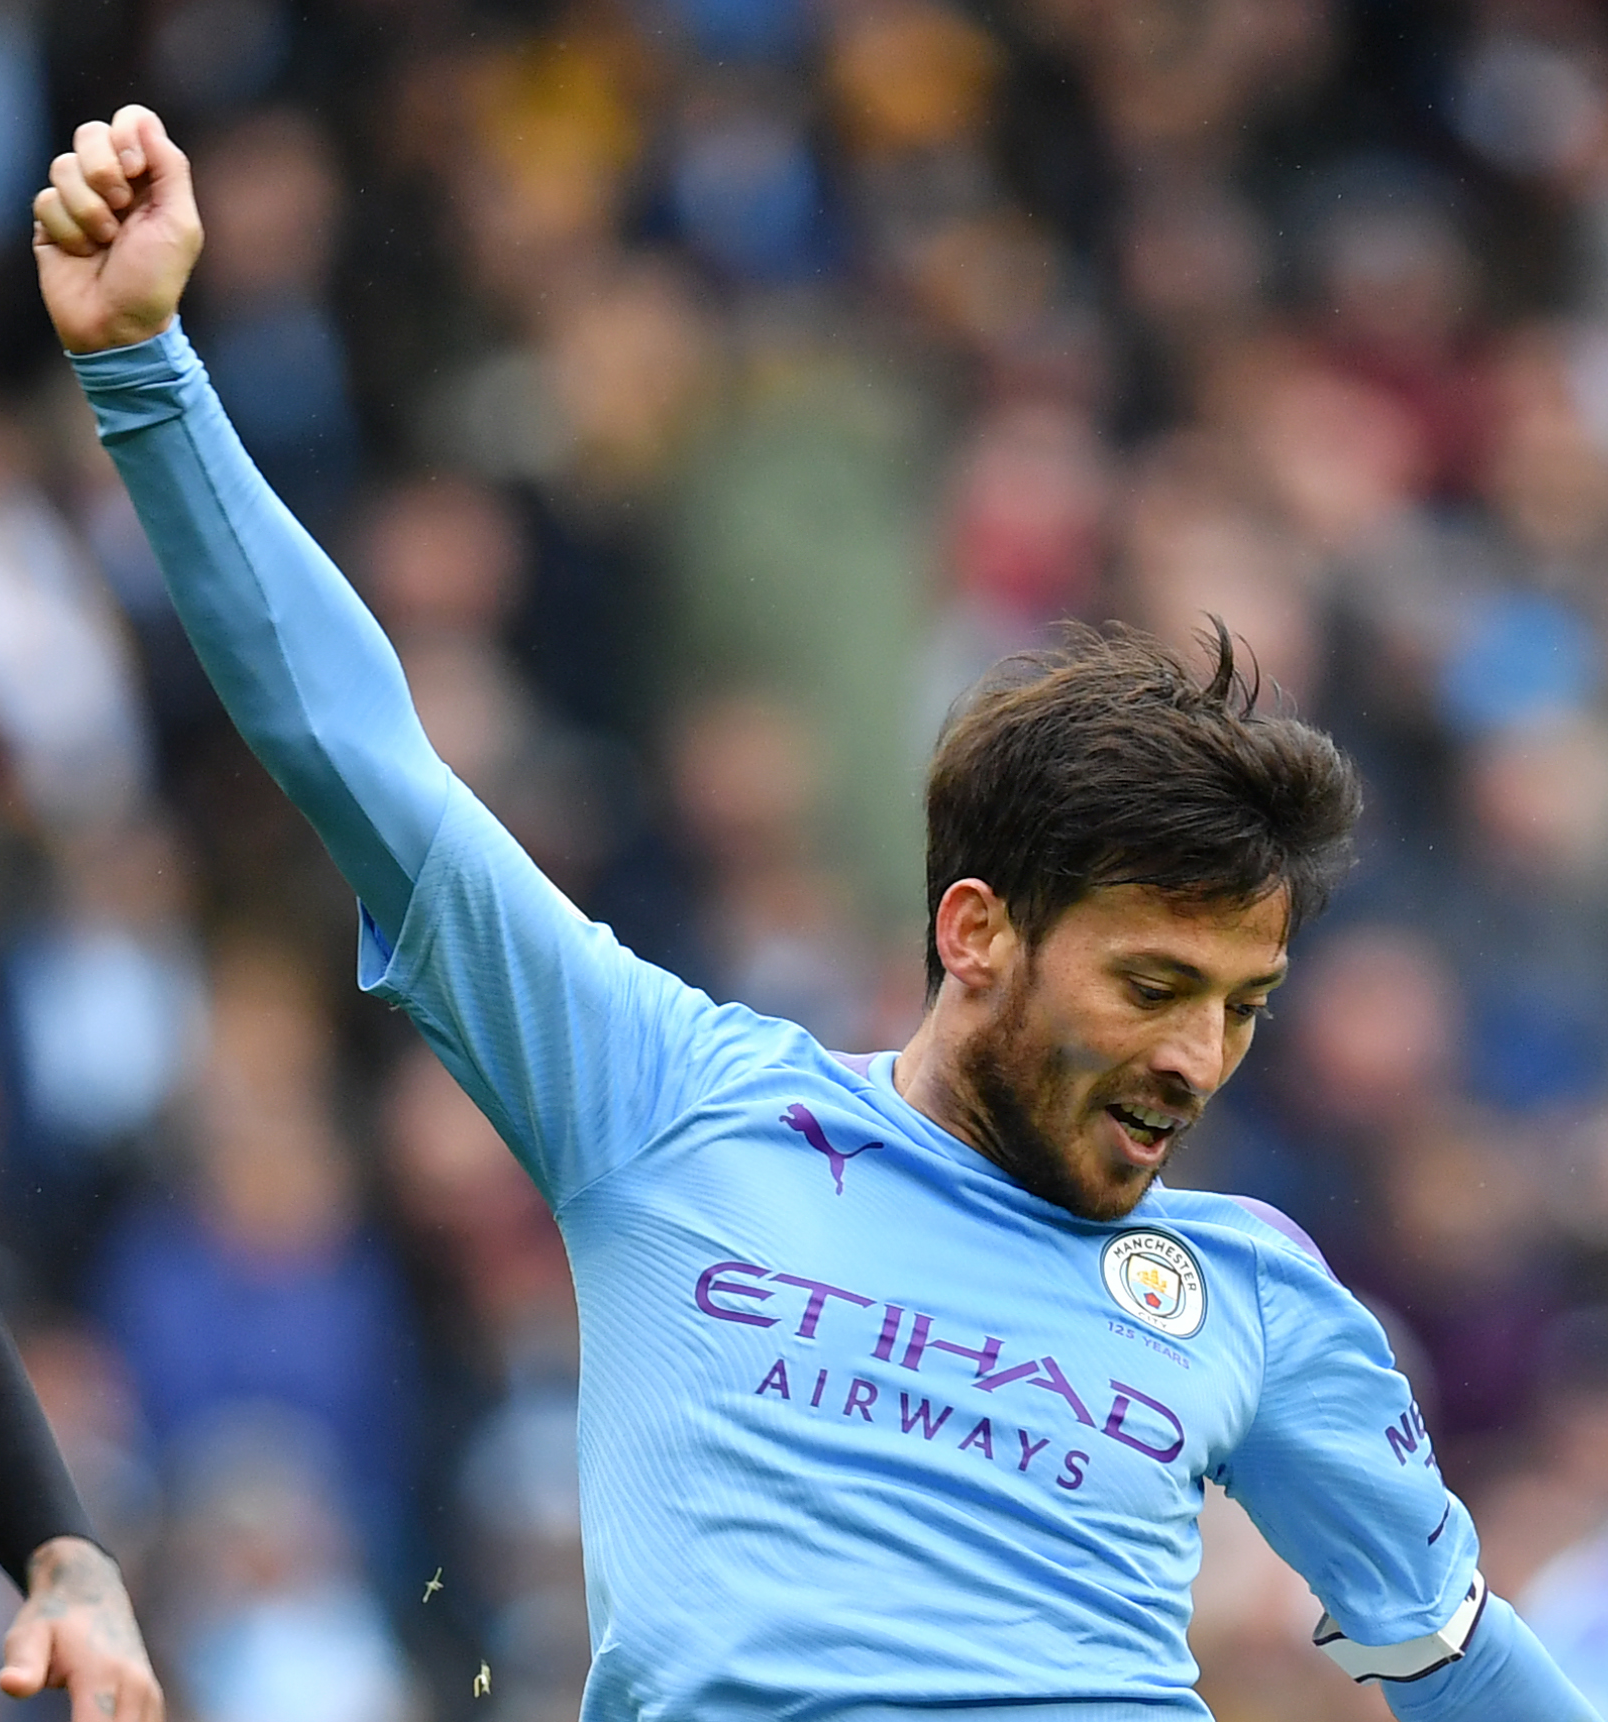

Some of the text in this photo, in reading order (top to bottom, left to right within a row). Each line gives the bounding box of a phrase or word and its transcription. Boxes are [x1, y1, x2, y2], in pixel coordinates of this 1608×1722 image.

[1113, 1237, 1197, 1292] MANCHESTER
[1108, 1321, 1190, 1370] 125 YEARS
[1138, 1311, 1167, 1329] CITY
[694, 1261, 1185, 1464] ETIHAD
[756, 1357, 1090, 1490] AIRWAYS
